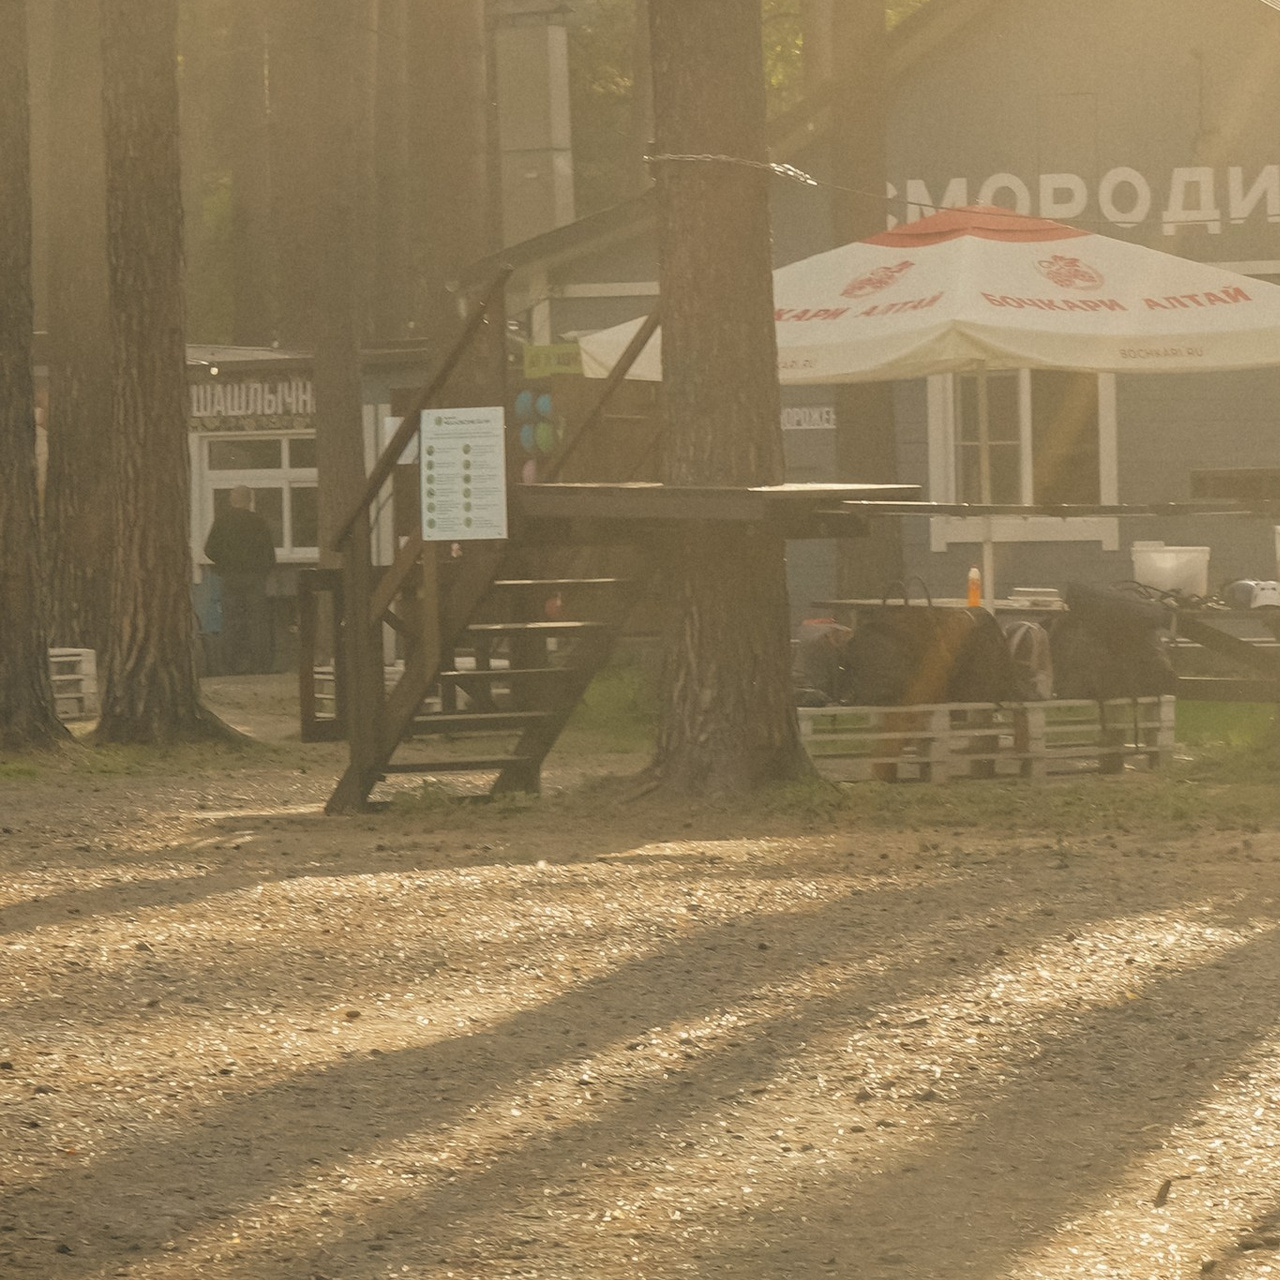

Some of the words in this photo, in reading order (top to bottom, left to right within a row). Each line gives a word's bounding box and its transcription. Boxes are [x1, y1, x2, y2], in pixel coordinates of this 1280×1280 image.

[980, 292, 1128, 312] БОЧКАРИ
[1142, 285, 1252, 310] АЛТАЙ
[190, 381, 316, 417] ШАШЛЫЧН
